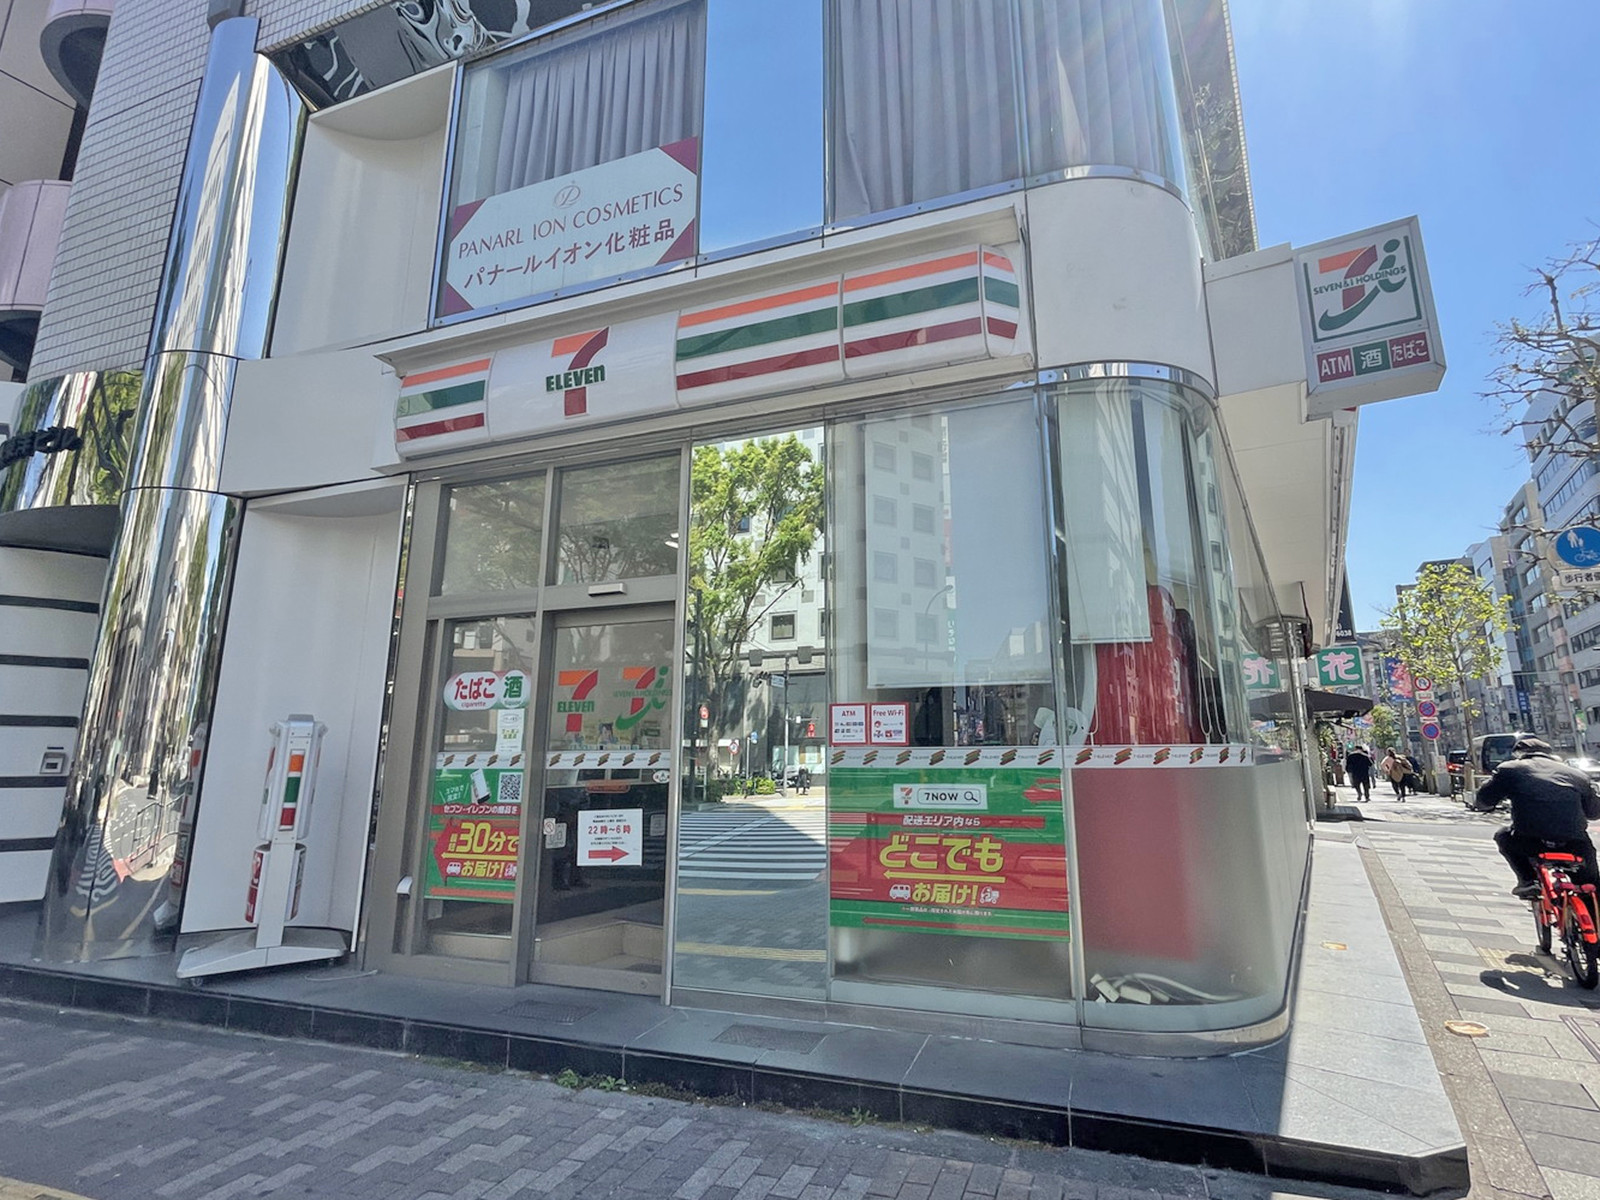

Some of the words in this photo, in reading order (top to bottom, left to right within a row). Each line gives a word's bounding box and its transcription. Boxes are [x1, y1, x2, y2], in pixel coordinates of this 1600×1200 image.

[458, 228, 524, 259] PANARL
[533, 217, 567, 241] ION
[572, 183, 684, 229] COSMETICS
[464, 218, 676, 289] パナールイオン化粧品
[1355, 264, 1408, 285] HOLDINGS
[1360, 348, 1384, 370] 酒
[1391, 339, 1429, 362] たばこ
[1321, 354, 1352, 377] ATM
[1322, 652, 1360, 682] 花
[454, 677, 496, 700] たばこ
[503, 676, 524, 699] 酒
[888, 709, 904, 717] Wi-Fi
[924, 792, 958, 801] 7NOW
[902, 814, 981, 826] 配送エリア内なら
[879, 835, 1004, 873] どこでも
